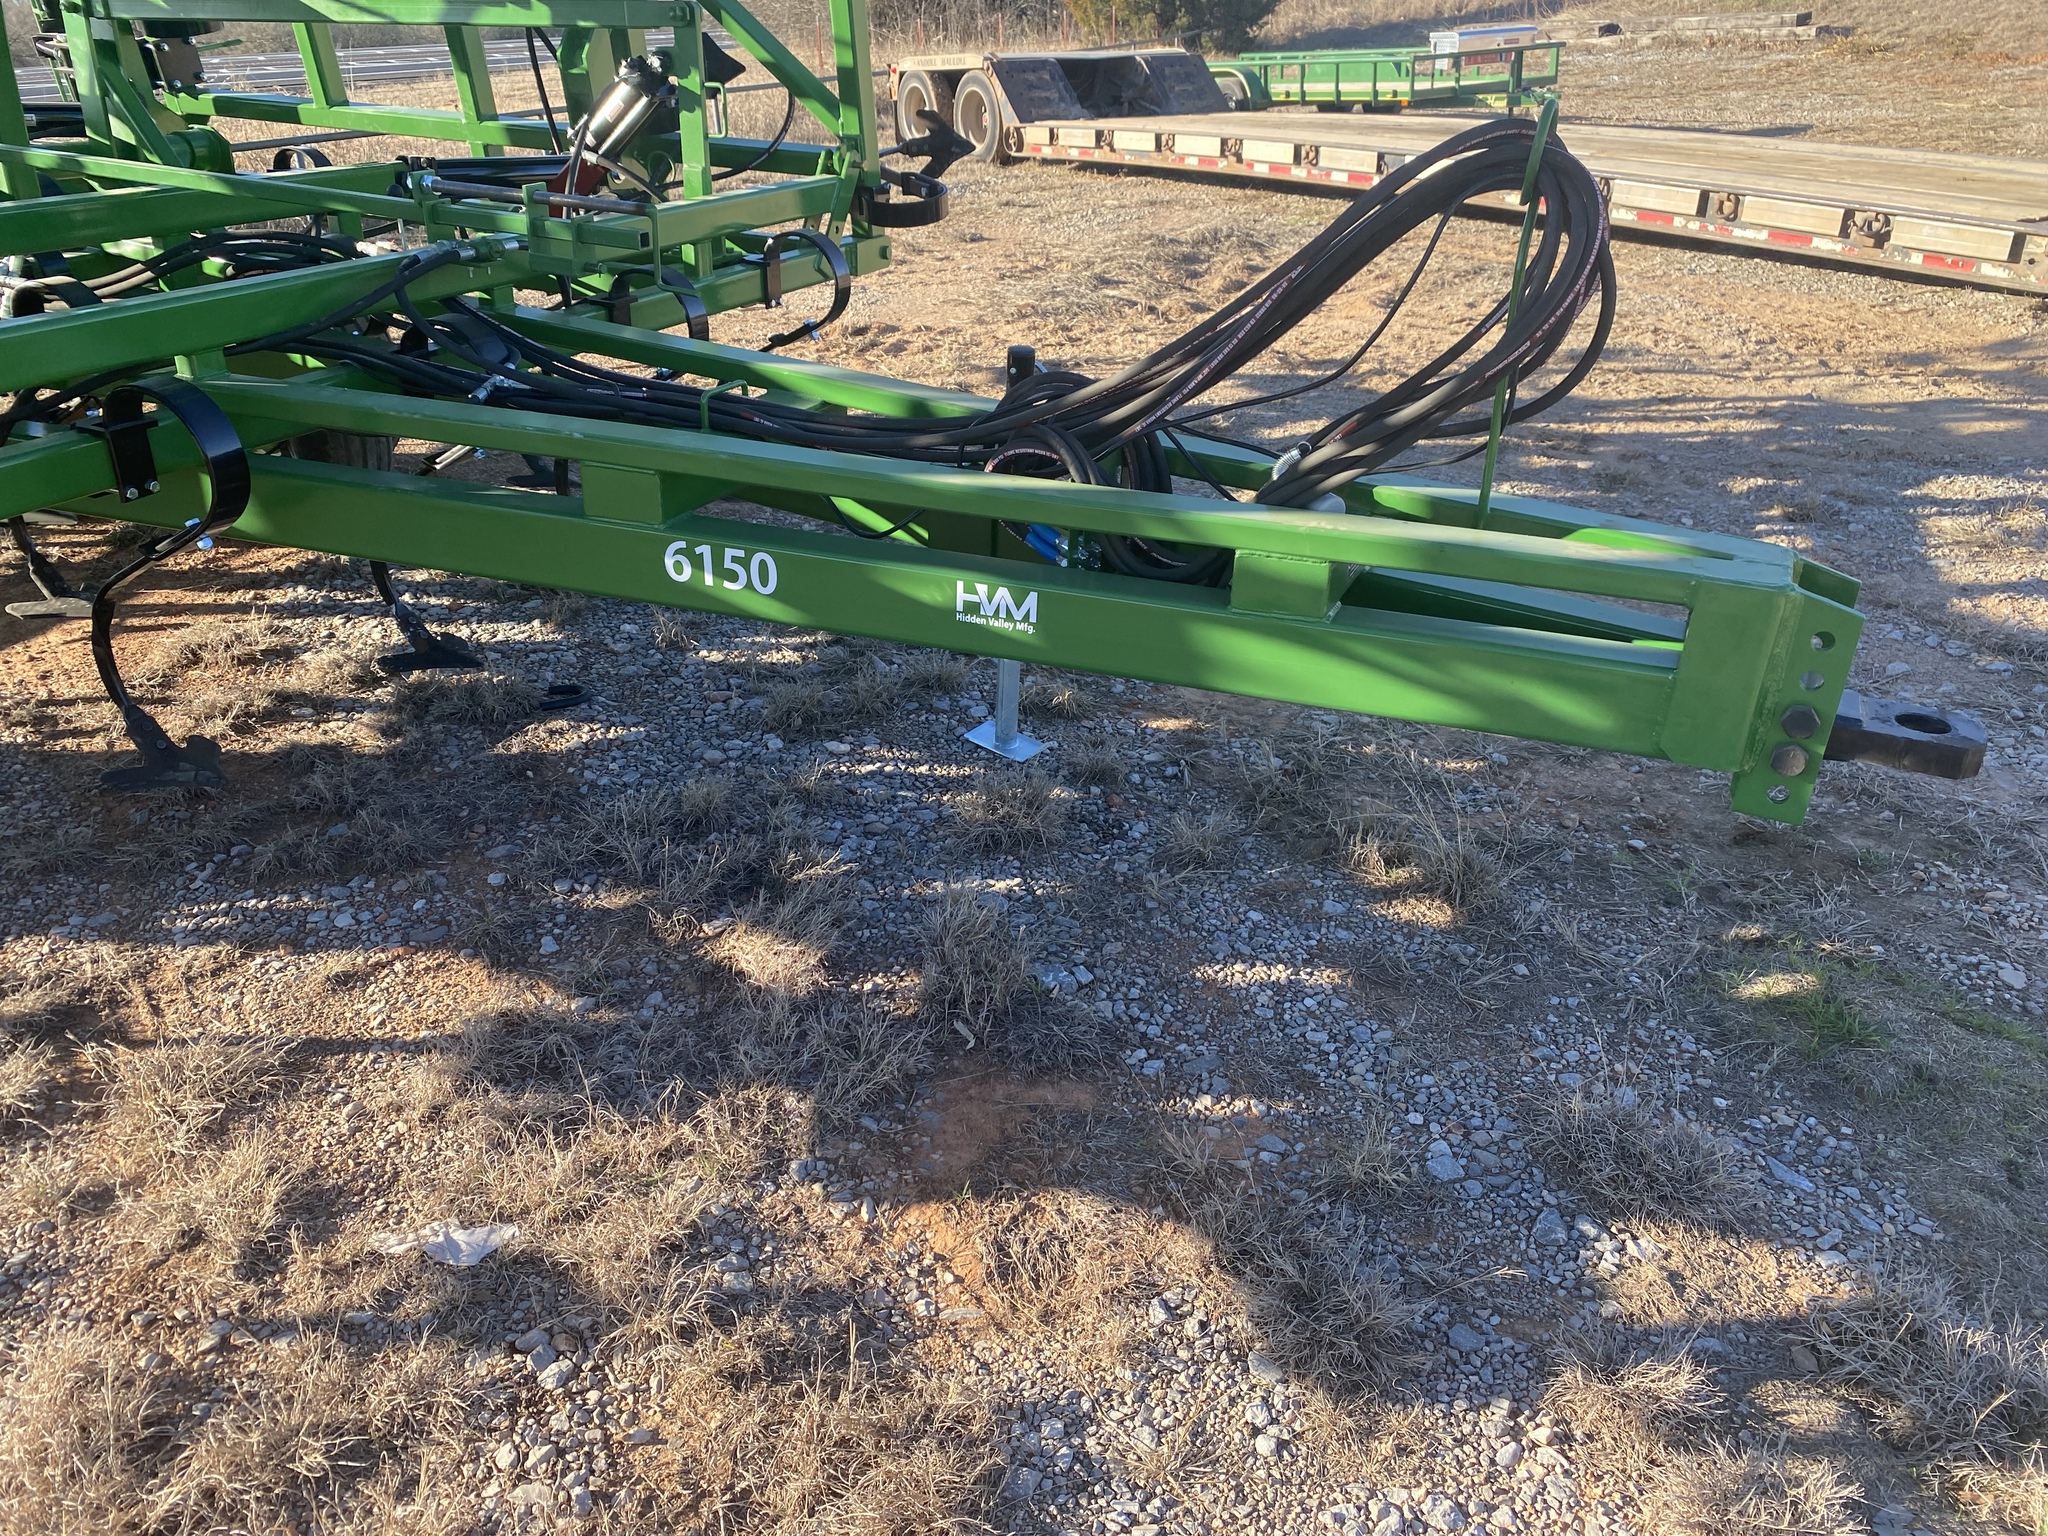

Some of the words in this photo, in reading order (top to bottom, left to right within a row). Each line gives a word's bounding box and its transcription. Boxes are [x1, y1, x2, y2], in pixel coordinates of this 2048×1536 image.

[664, 540, 778, 595] 6150
[956, 613, 986, 625] Hidden
[988, 617, 1014, 632] Valley
[1016, 622, 1036, 635] Mfg.
